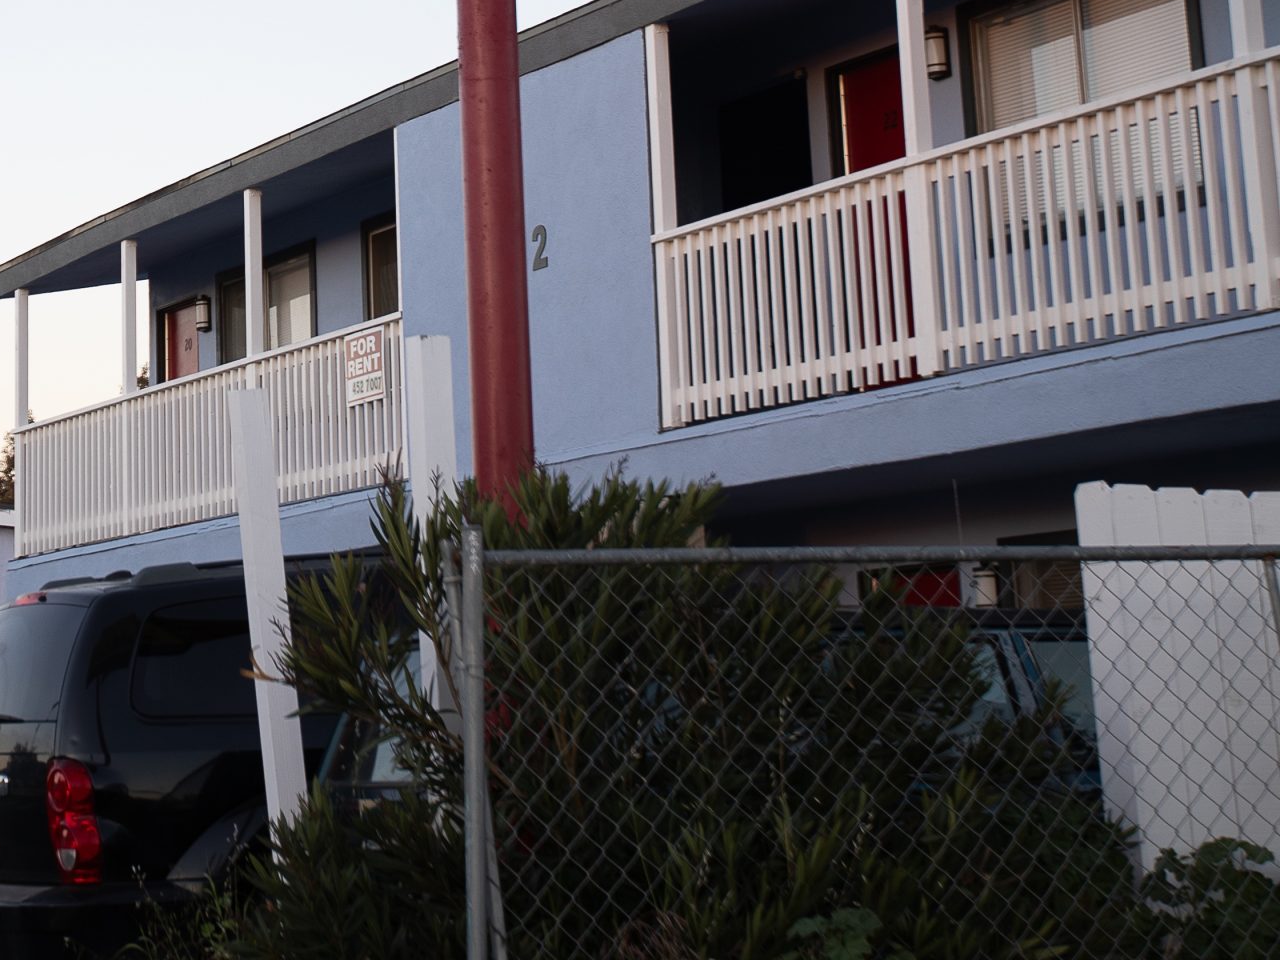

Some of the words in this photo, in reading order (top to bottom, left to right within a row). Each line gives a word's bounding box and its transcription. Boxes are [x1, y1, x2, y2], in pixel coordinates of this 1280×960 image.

[531, 224, 549, 272] 2
[350, 335, 376, 358] FOR
[347, 352, 380, 379] RENT
